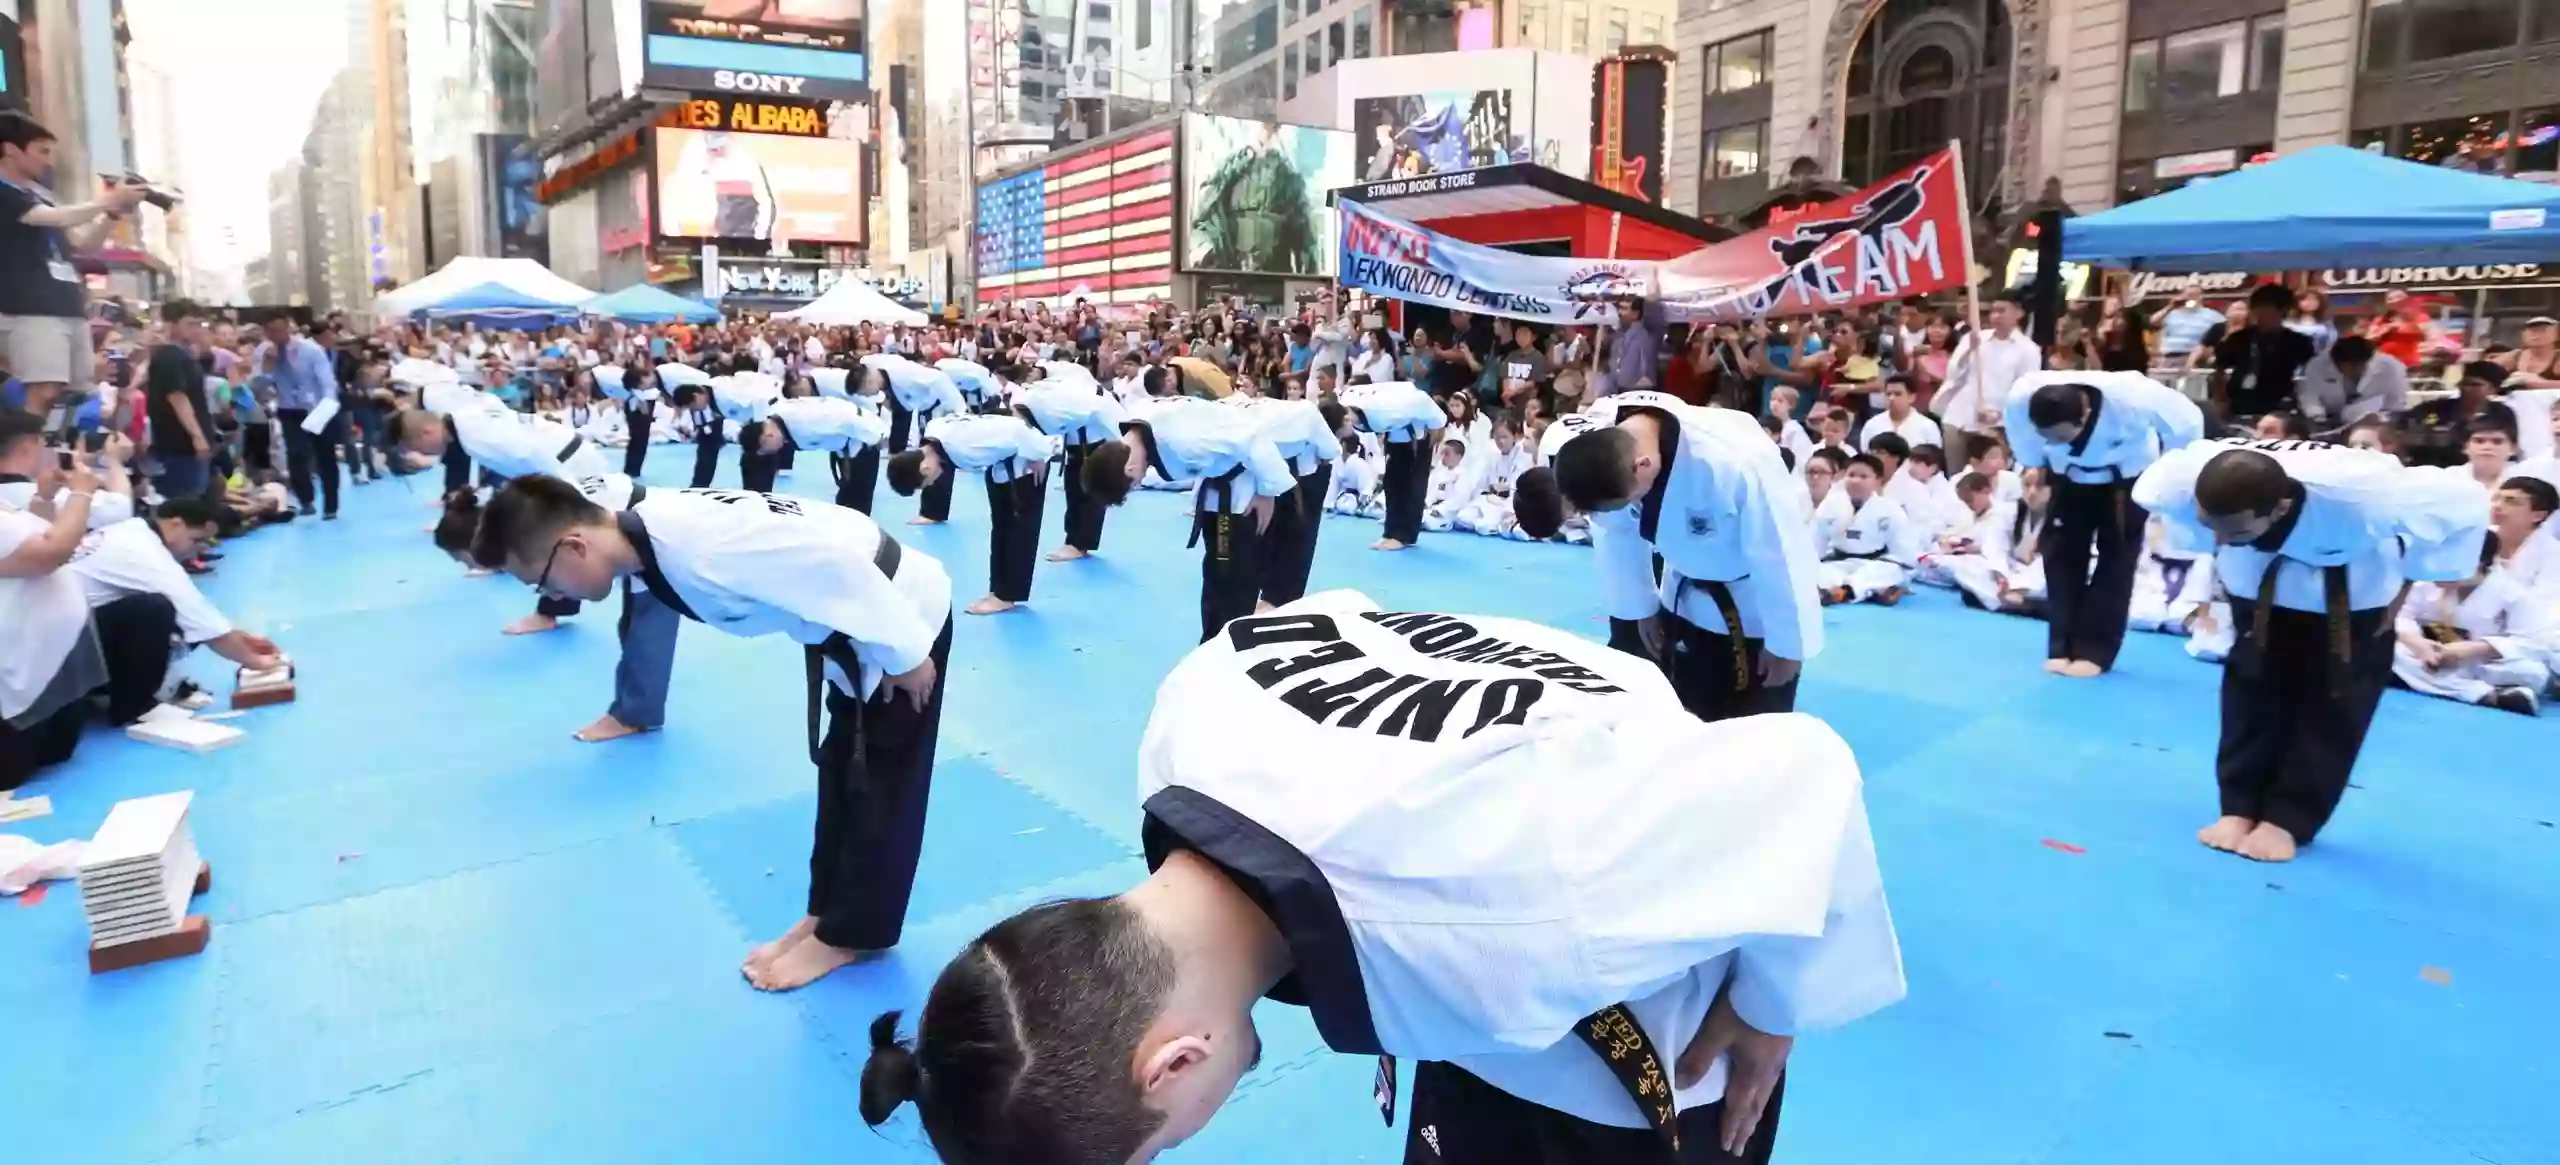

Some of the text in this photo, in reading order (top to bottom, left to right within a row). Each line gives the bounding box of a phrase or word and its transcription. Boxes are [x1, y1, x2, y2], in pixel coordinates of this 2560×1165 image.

[713, 69, 806, 94] SONY
[1367, 172, 1476, 198] STRAND BOOK STORE
[1786, 219, 1944, 306] TEAM
[2323, 263, 2541, 286] CLUBHOUSE
[1228, 614, 1544, 742] UNITED
